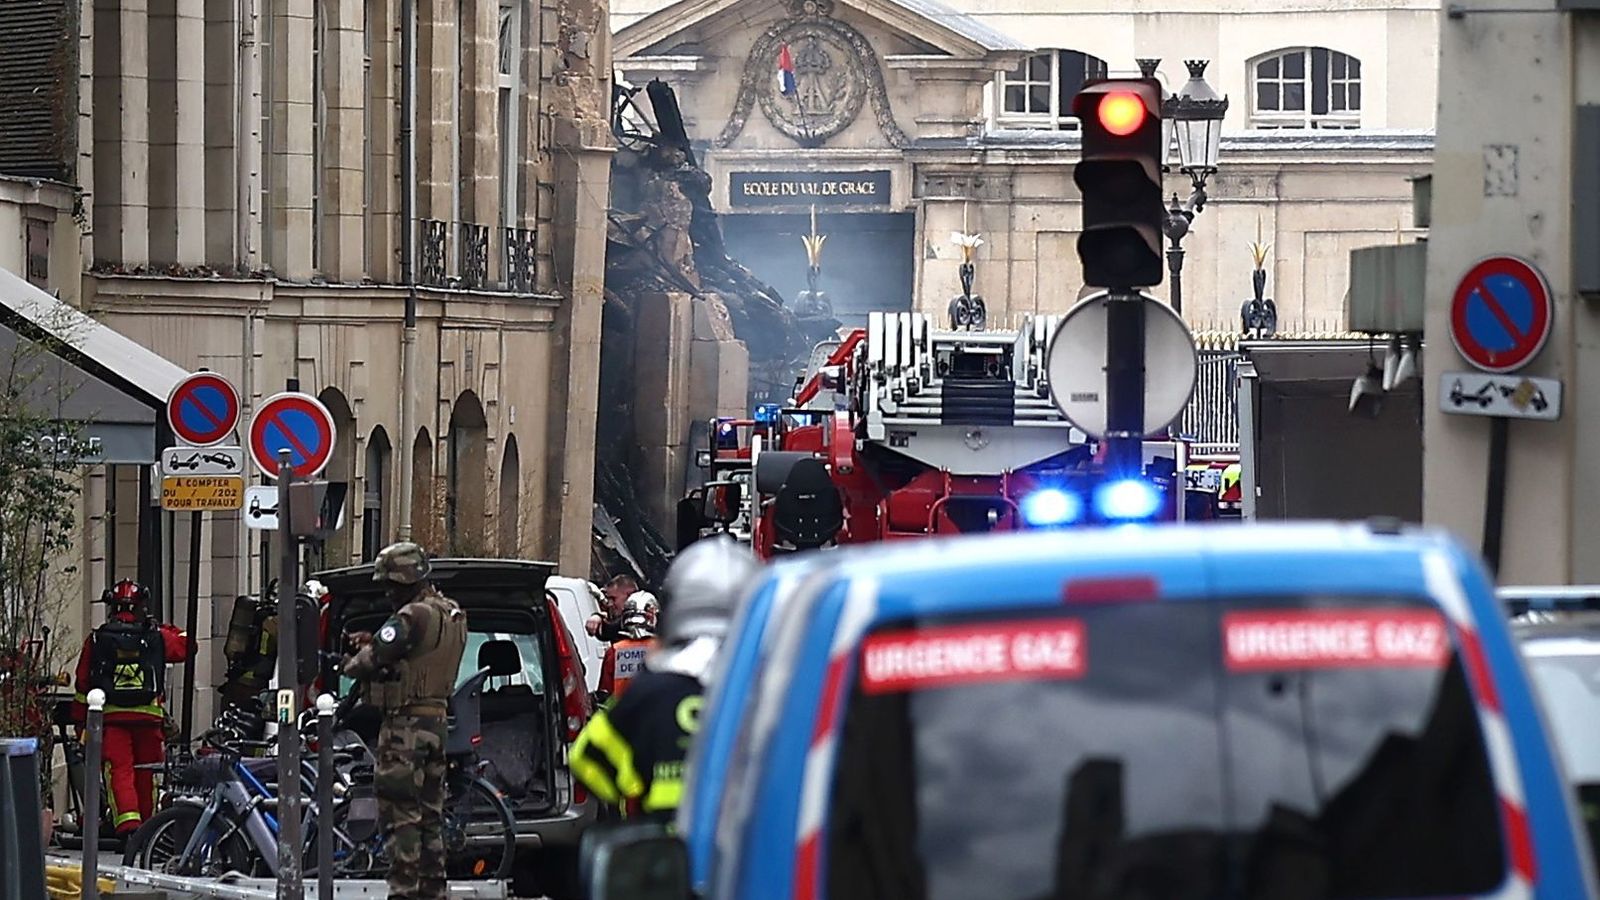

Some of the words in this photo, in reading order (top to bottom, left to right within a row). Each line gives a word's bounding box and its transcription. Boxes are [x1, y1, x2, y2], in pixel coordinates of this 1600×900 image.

[781, 182, 799, 196] DU
[800, 182, 821, 195] VAL
[822, 182, 838, 195] DE
[186, 479, 229, 487] COMPTER
[163, 489, 176, 497] DU
[167, 499, 192, 507] POUR
[196, 499, 236, 507] TRAVAUX
[1226, 619, 1370, 662] URGENCE
[1374, 619, 1444, 661] GAZ
[865, 634, 1005, 682] URGENCE
[1010, 630, 1079, 672] GAZ
